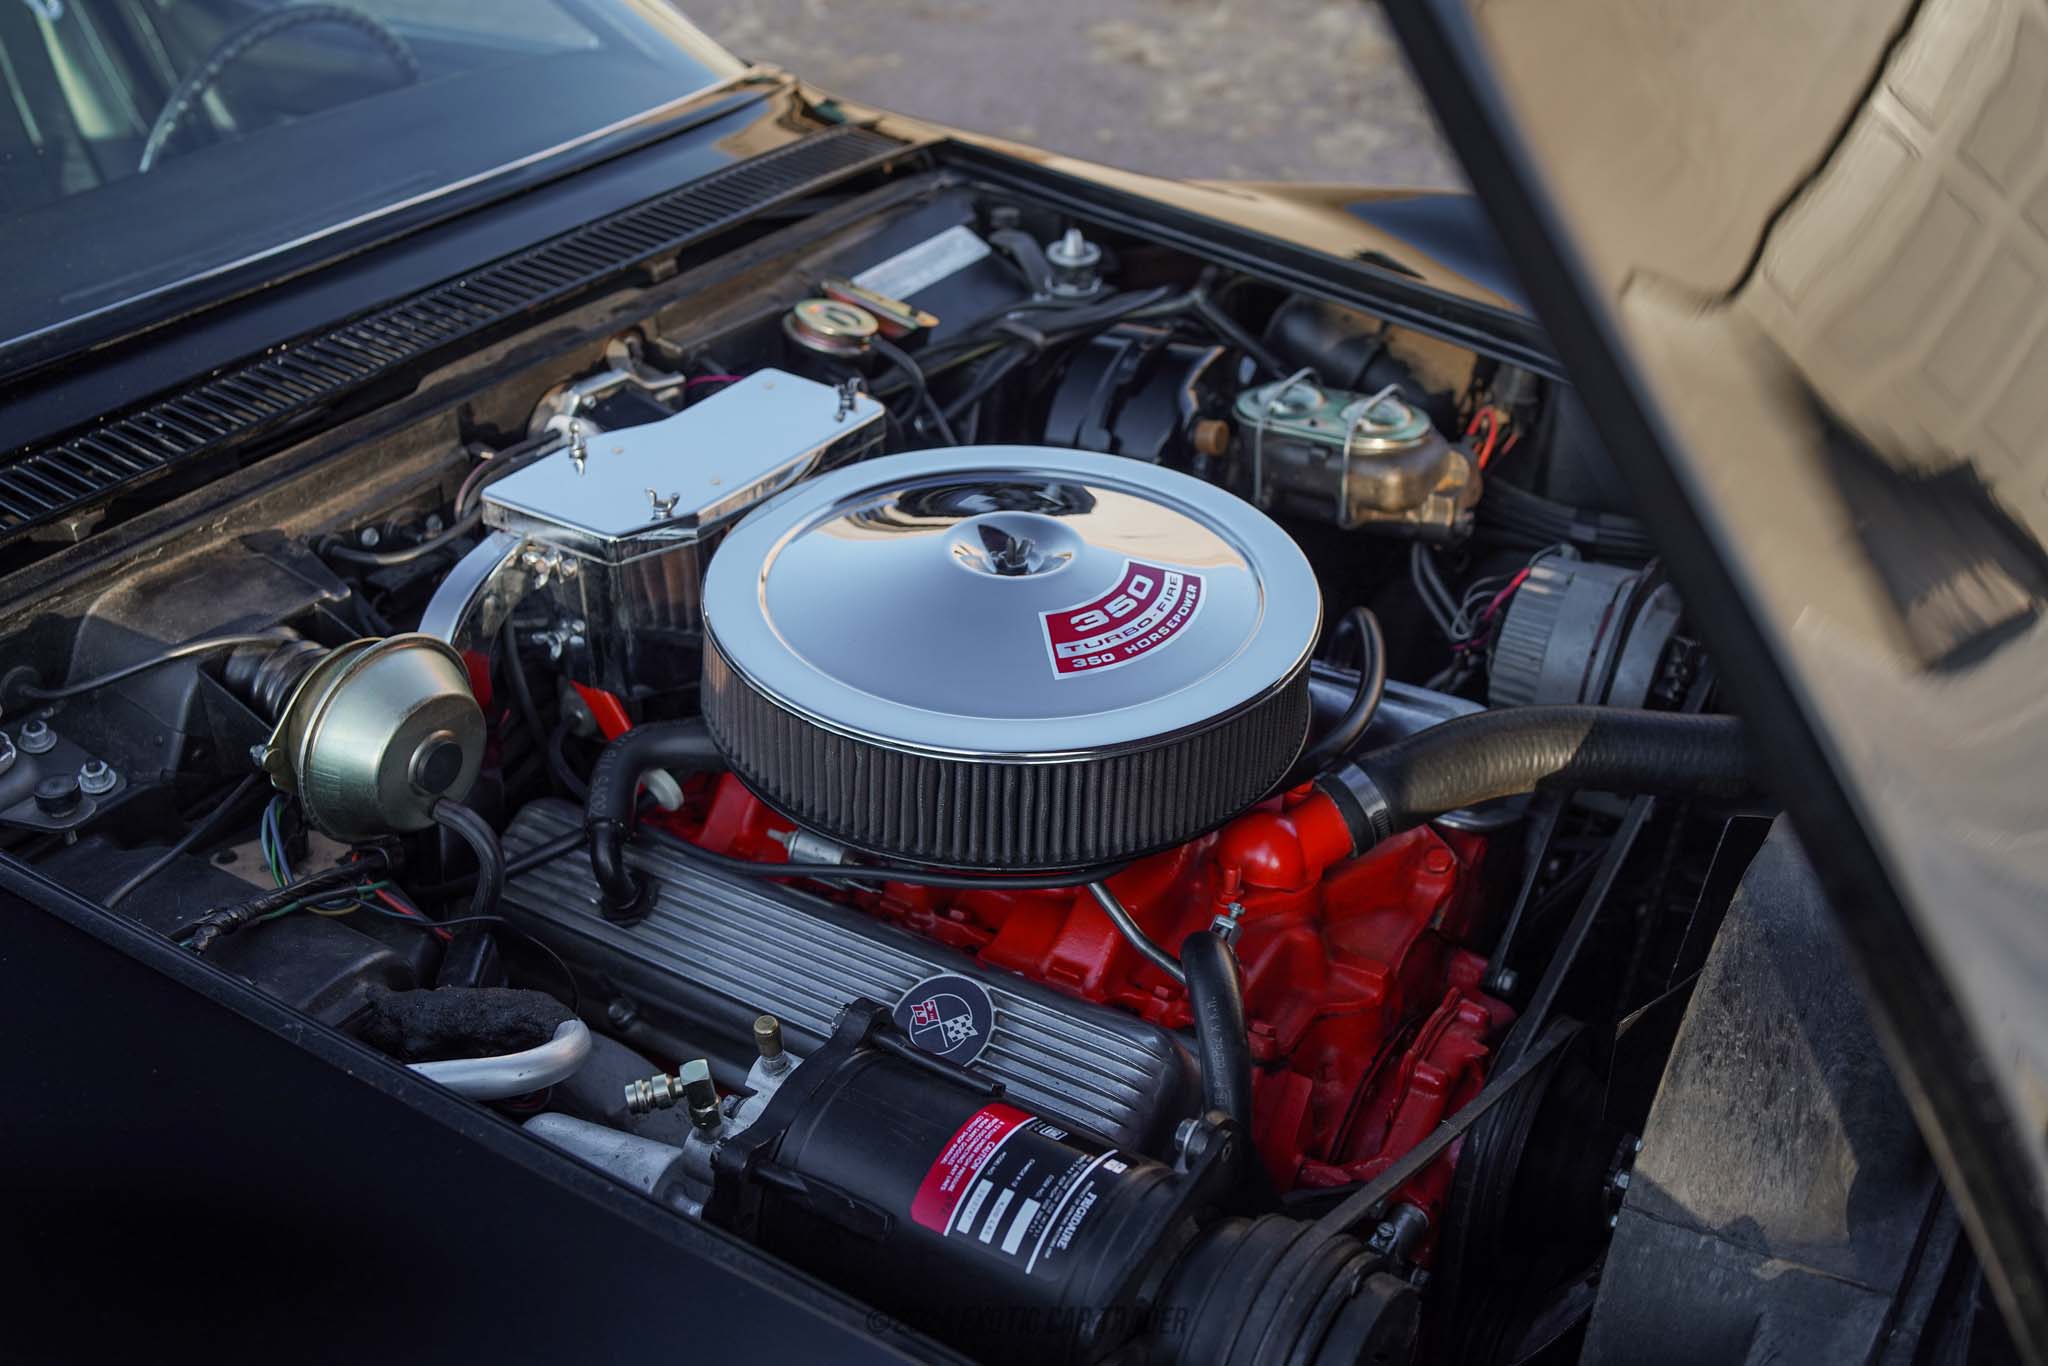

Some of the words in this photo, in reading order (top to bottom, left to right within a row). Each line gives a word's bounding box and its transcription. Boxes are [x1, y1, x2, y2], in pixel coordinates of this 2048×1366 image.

[1063, 575, 1179, 653] TURBO-FIRE
[1070, 573, 1154, 632] 350
[1071, 652, 1116, 668] 350
[1124, 583, 1199, 654] HORSEPOWER
[970, 1140, 995, 1170] CAUTION
[1055, 1191, 1097, 1250] FRIGIDAIRE
